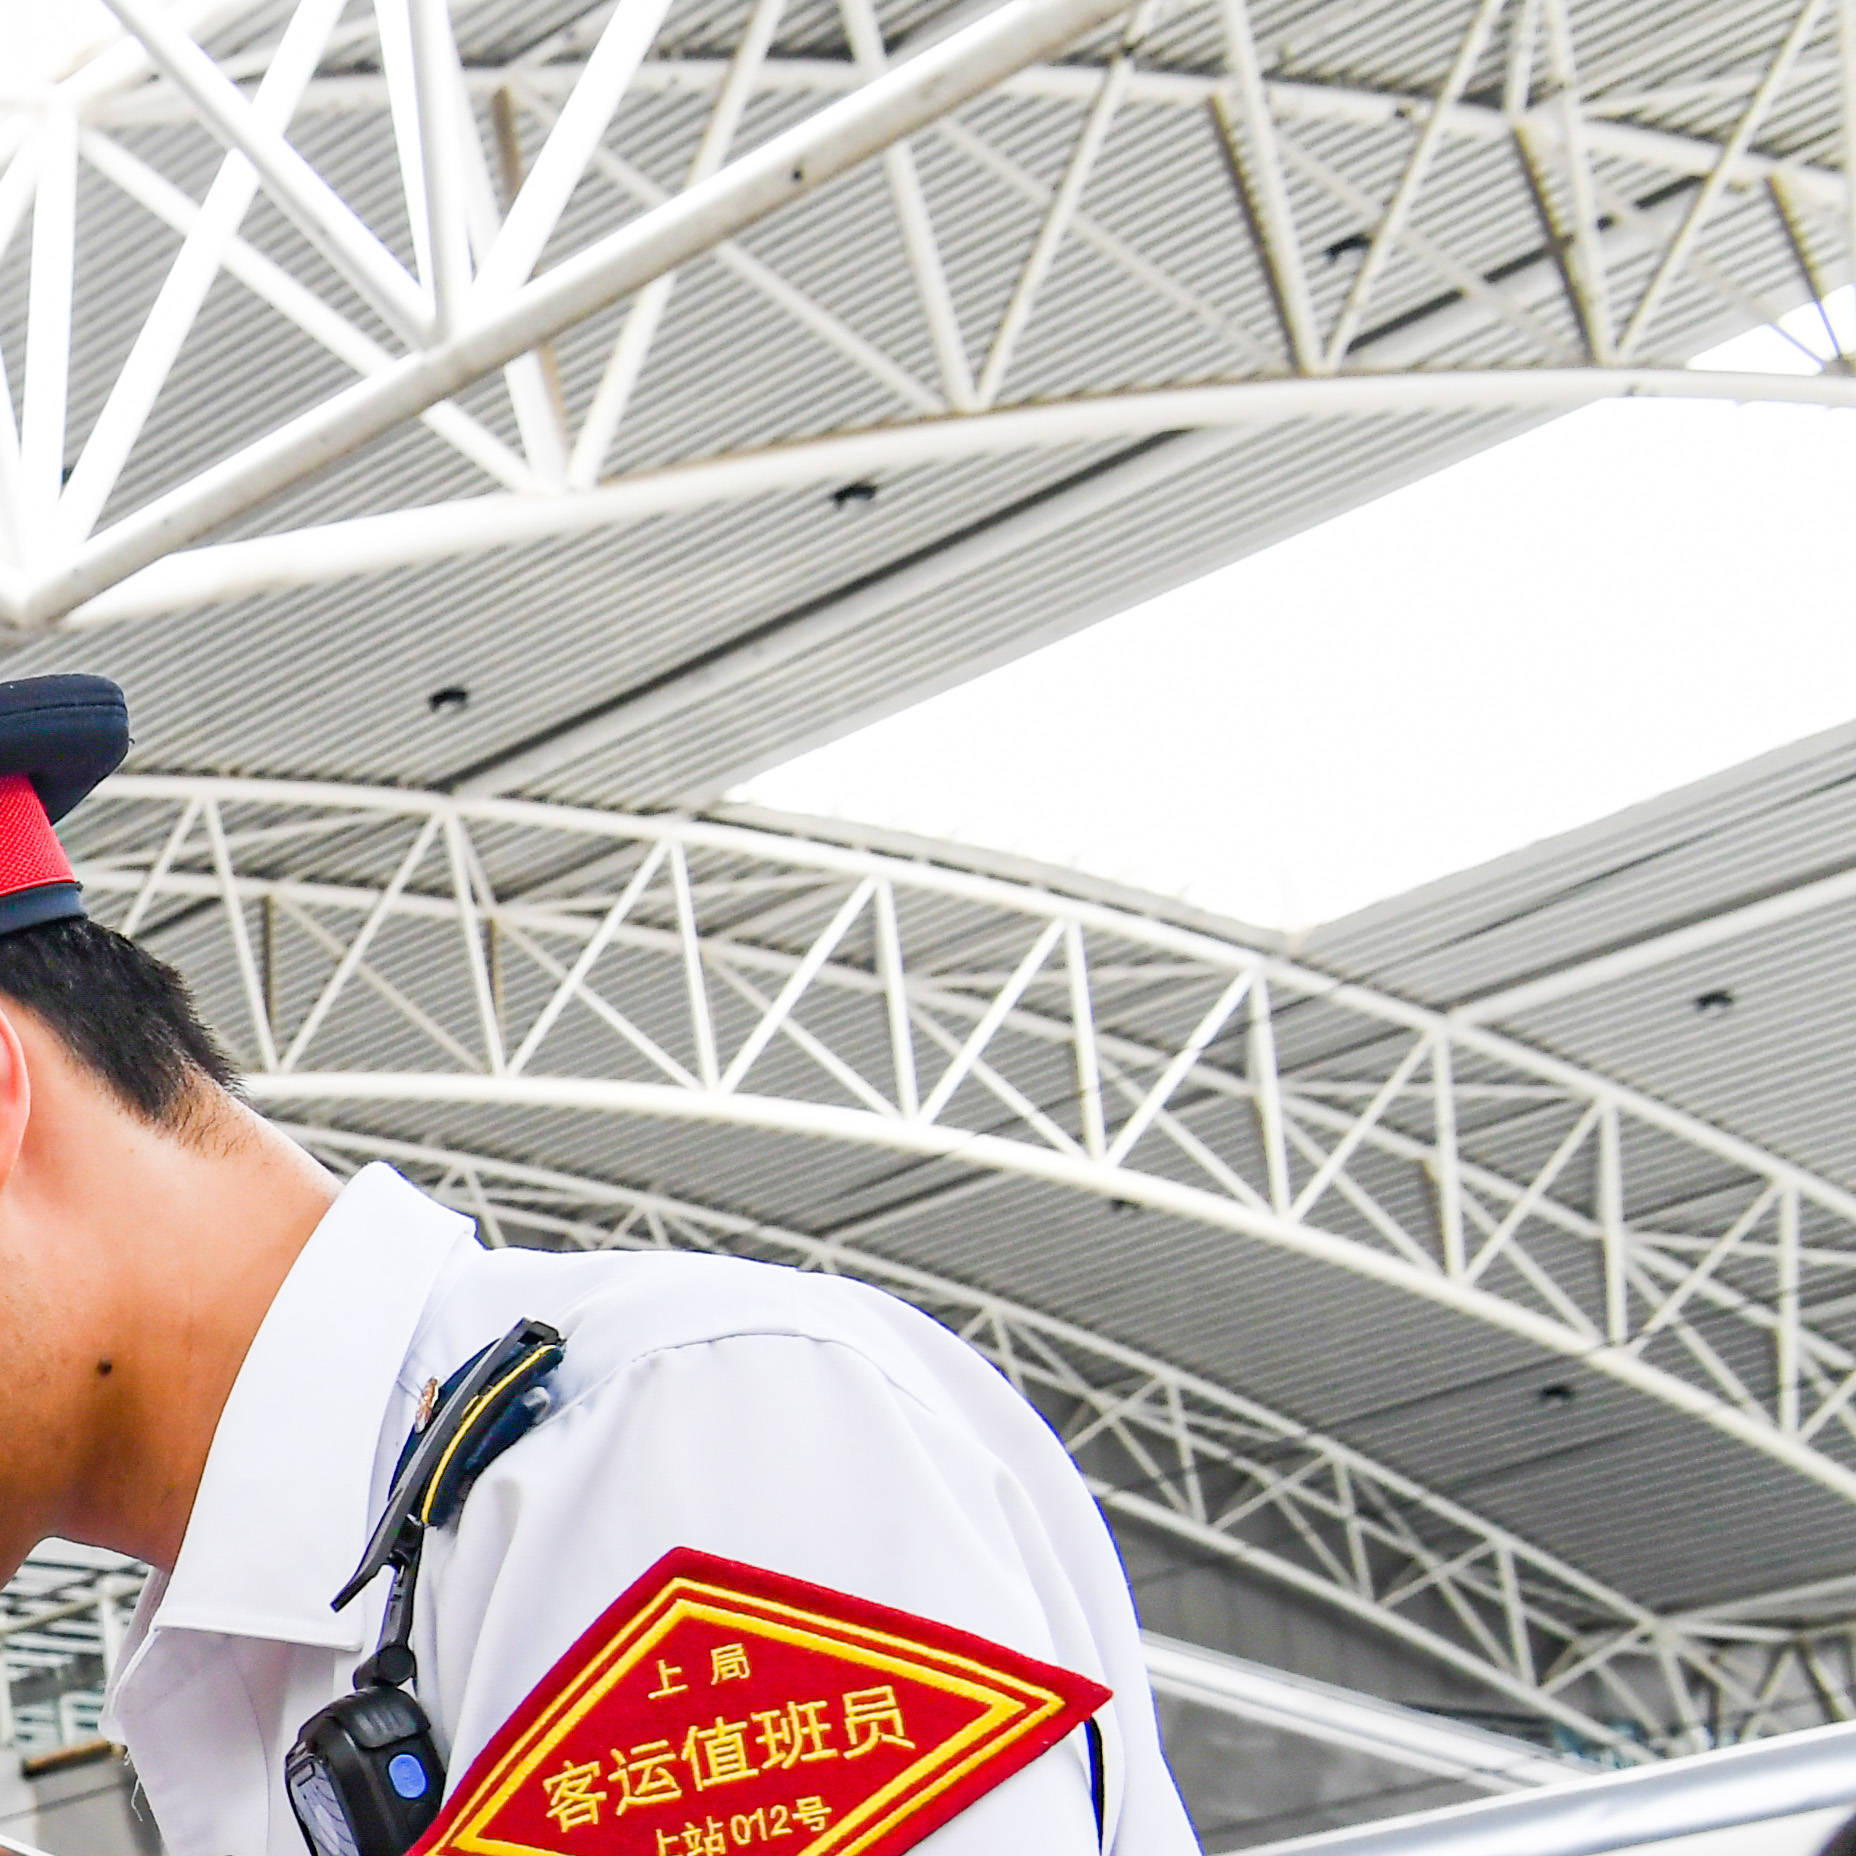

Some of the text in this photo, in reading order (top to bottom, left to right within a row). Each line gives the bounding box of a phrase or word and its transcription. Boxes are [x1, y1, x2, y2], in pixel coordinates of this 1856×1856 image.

[648, 1642, 751, 1700] 上局
[542, 1684, 916, 1833] 客运值班员
